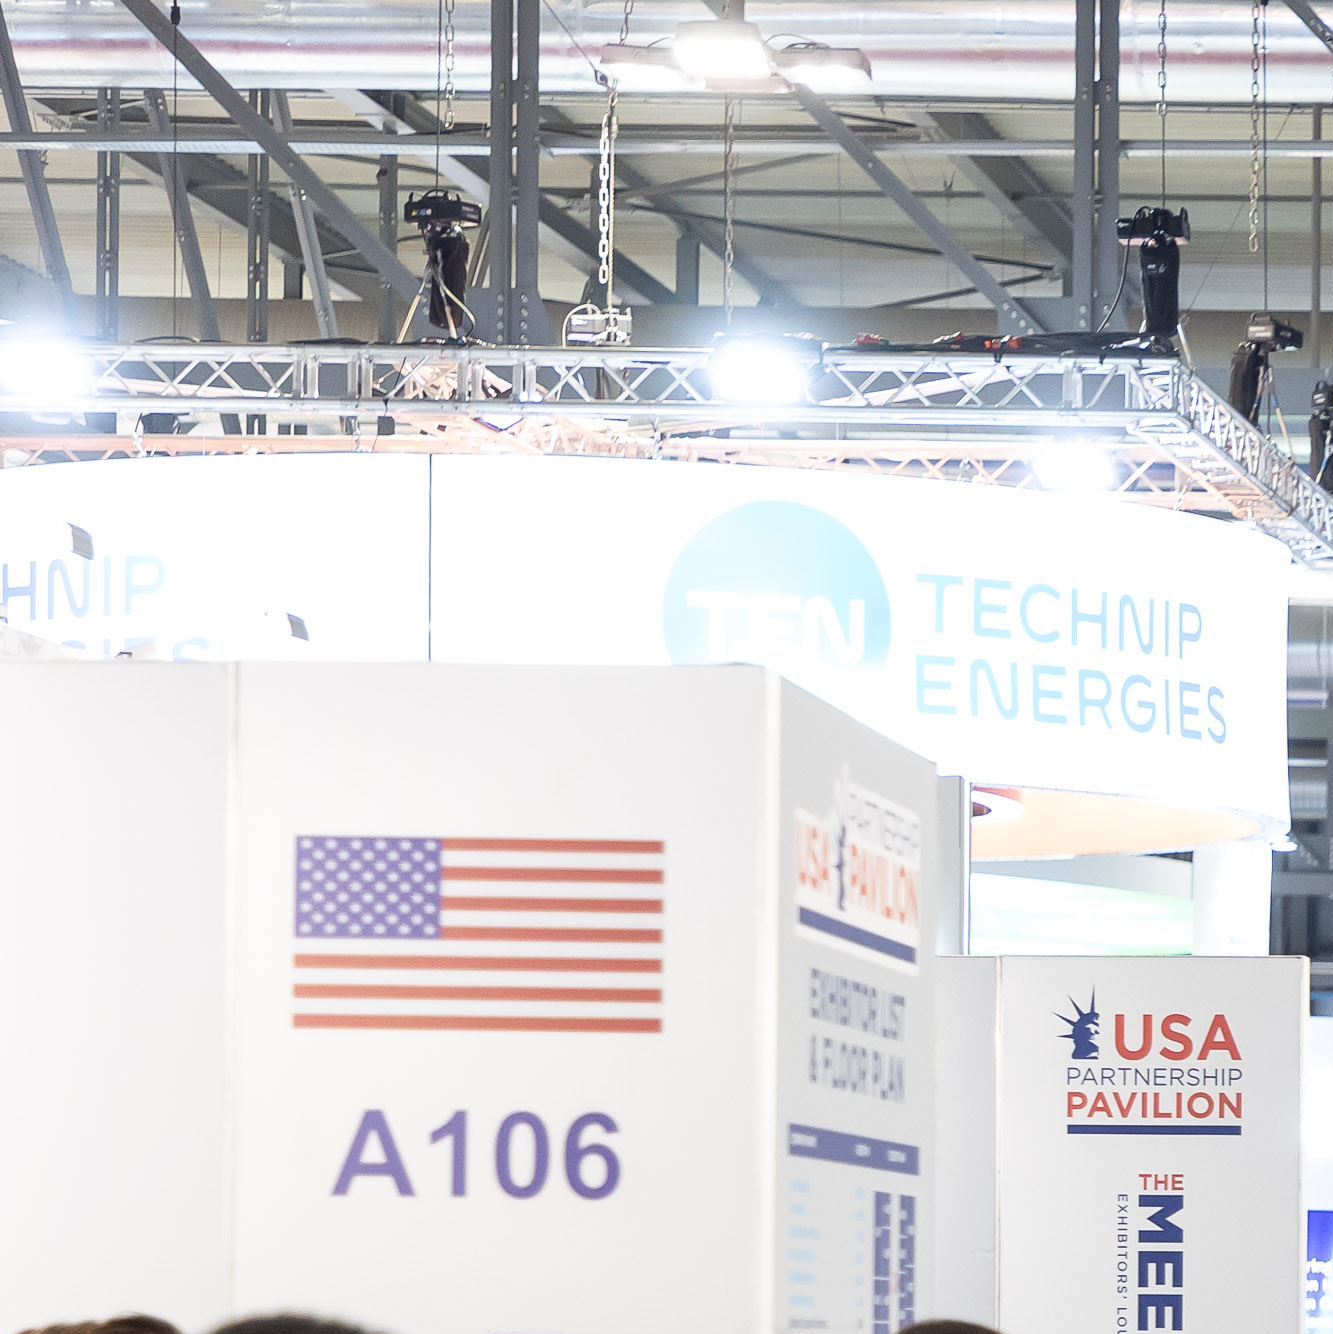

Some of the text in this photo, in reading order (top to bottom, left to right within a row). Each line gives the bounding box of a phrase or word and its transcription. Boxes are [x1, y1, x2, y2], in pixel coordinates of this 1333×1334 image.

[687, 590, 866, 666] TEN
[916, 573, 1203, 660] TECHNIP
[915, 655, 1227, 744] ENERGIES
[1114, 1014, 1243, 1061] USA
[1067, 1067, 1243, 1087] PARTNERSHIP
[1067, 1092, 1243, 1119] PAVILION
[331, 1109, 622, 1200] A106
[1139, 1174, 1184, 1191] THE
[1117, 1193, 1129, 1300] EXHIBITORS'
